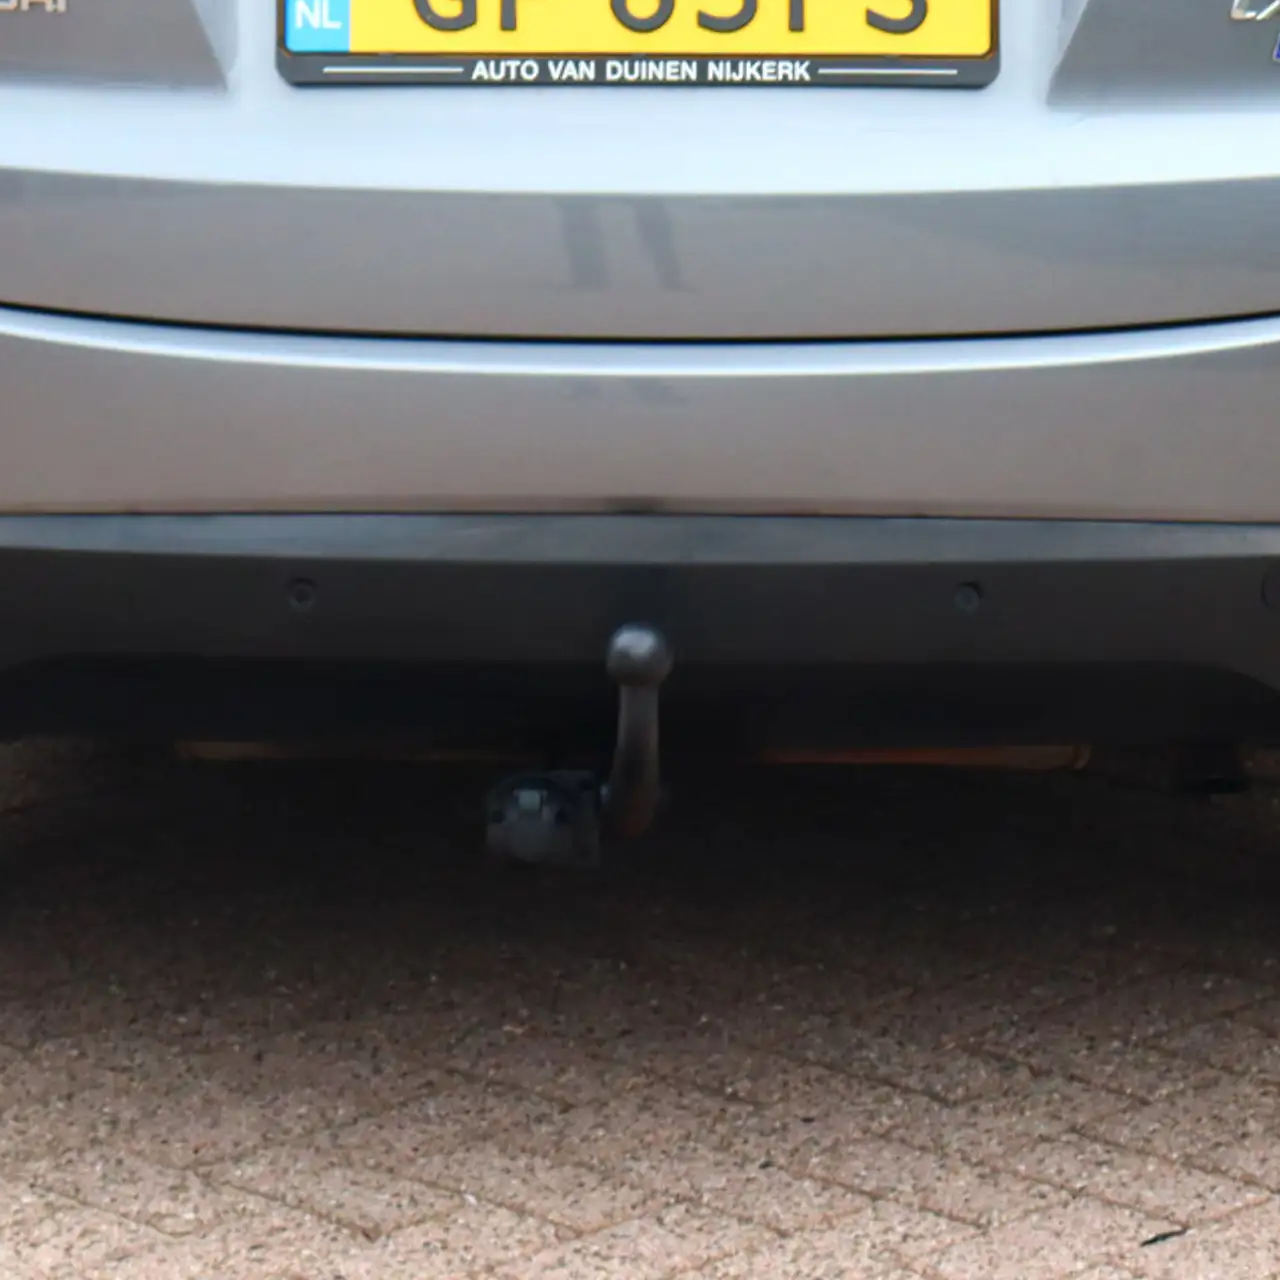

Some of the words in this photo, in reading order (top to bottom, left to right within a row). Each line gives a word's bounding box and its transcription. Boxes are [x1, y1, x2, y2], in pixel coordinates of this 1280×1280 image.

[471, 59, 540, 81] AUTO
[548, 59, 596, 81] VAN
[605, 59, 698, 82] DUINEN
[707, 60, 812, 82] NIJKERK
